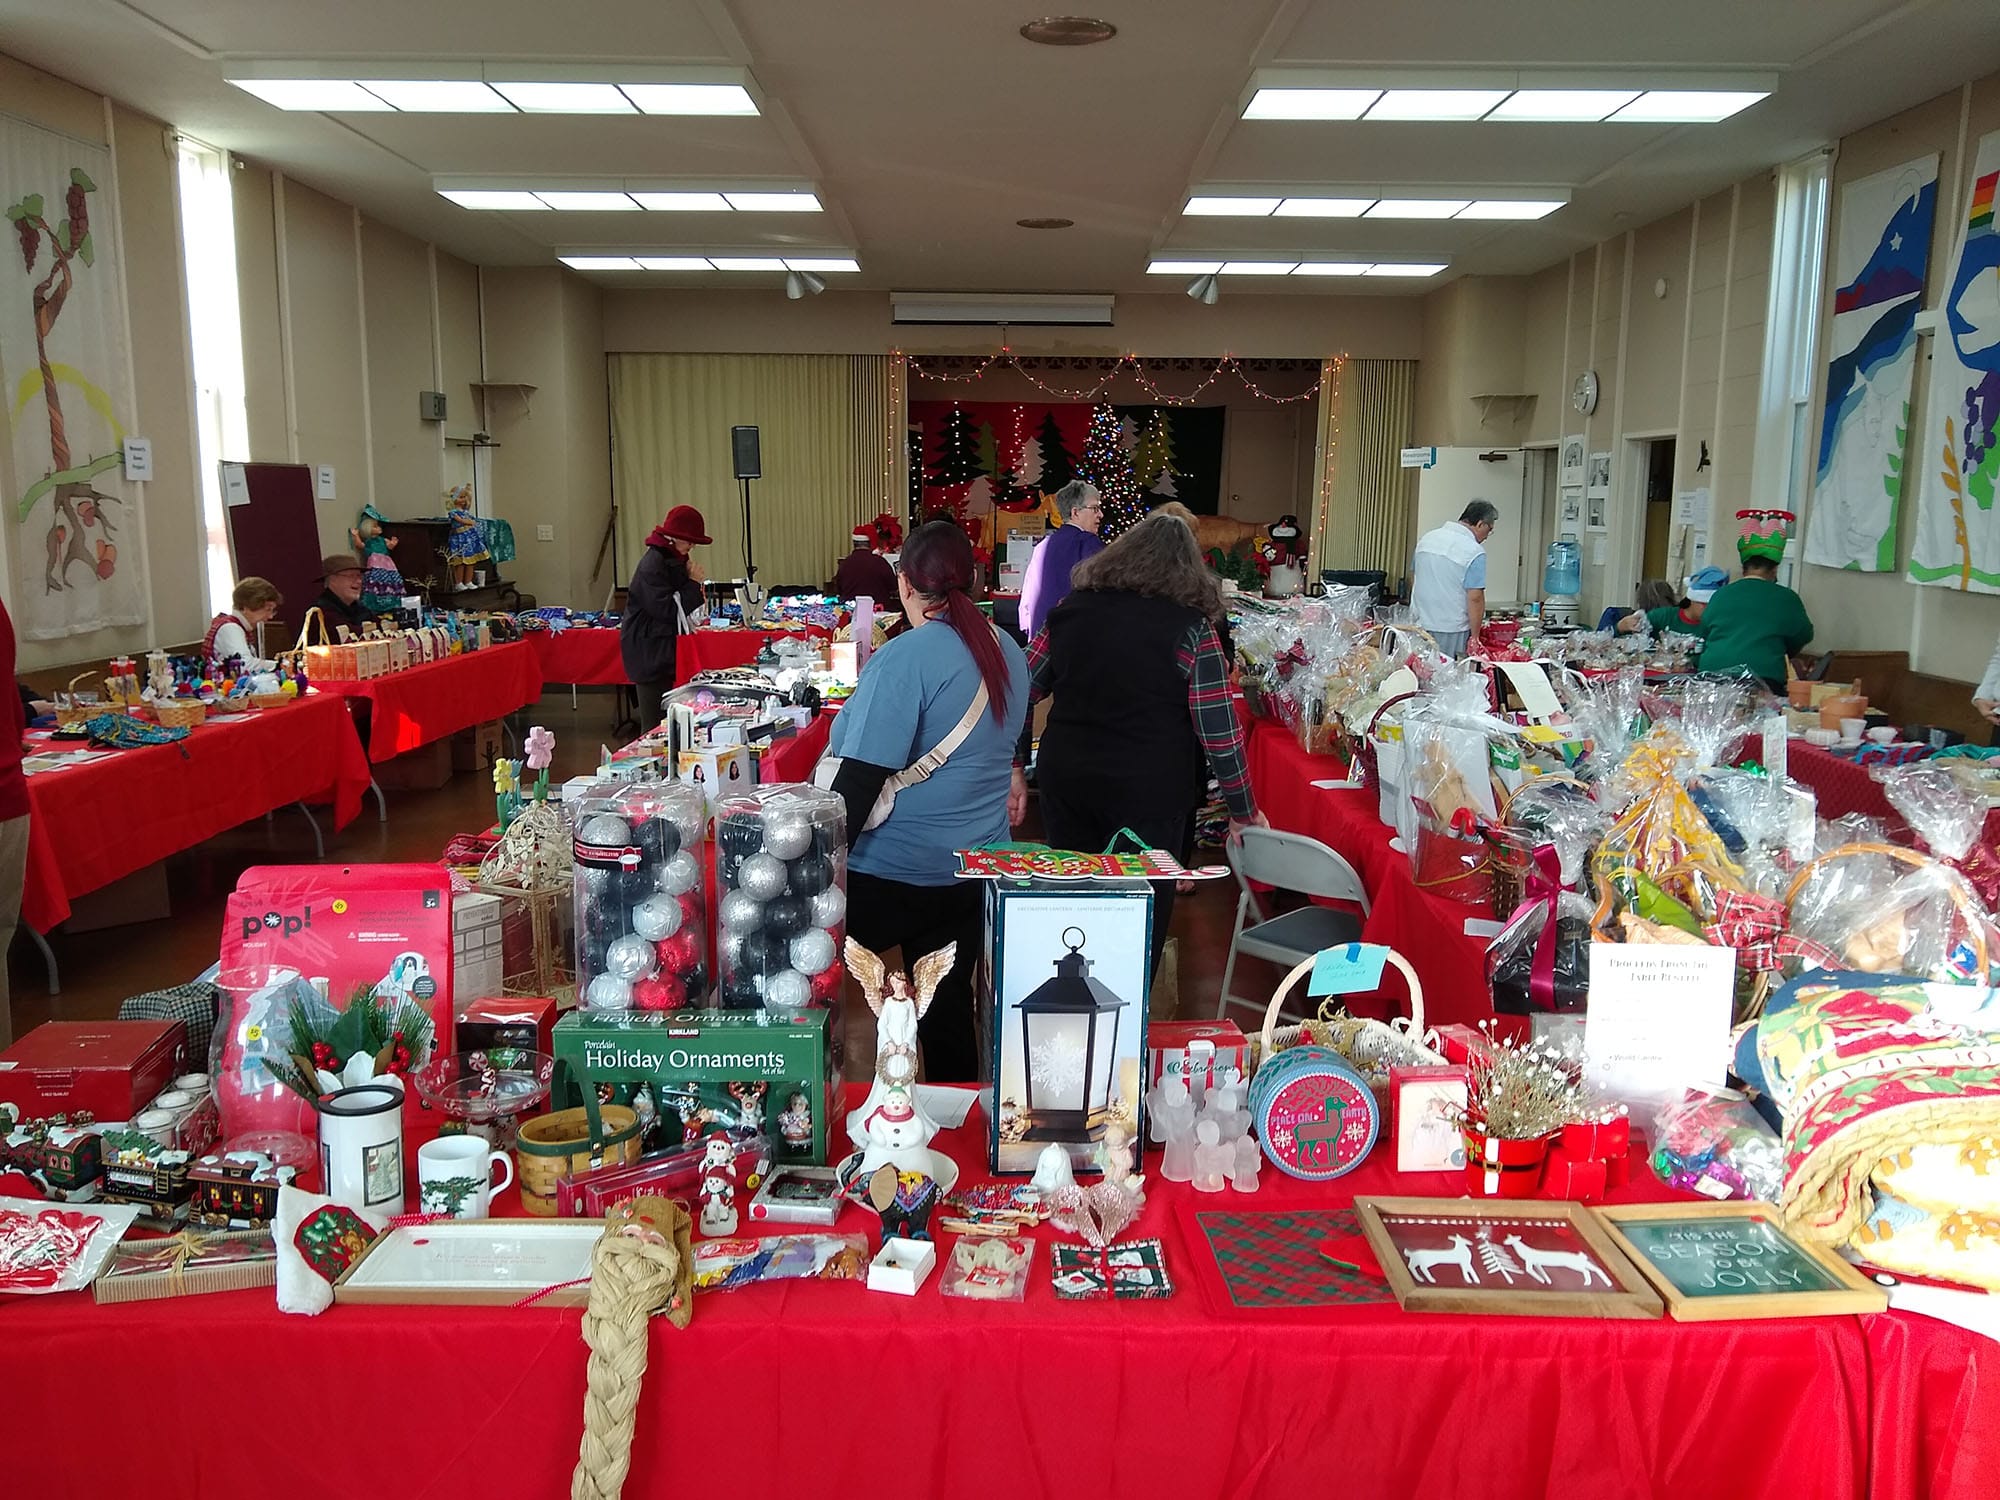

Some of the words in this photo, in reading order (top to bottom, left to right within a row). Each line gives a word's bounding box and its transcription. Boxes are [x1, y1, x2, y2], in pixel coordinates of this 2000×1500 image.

[242, 906, 312, 939] pop!
[584, 1040, 616, 1050] Porcelain
[586, 1050, 665, 1072] Holiday
[669, 1050, 785, 1068] Ornaments
[1271, 1114, 1297, 1125] PEACE
[1298, 1112, 1313, 1123] ON
[1341, 1108, 1367, 1118] EARTH
[1704, 1230, 1739, 1240] THE
[1650, 1241, 1790, 1260] SEASON
[1705, 1259, 1732, 1269] TO
[1736, 1258, 1763, 1268] BE
[1700, 1268, 1802, 1288] JOLLY
